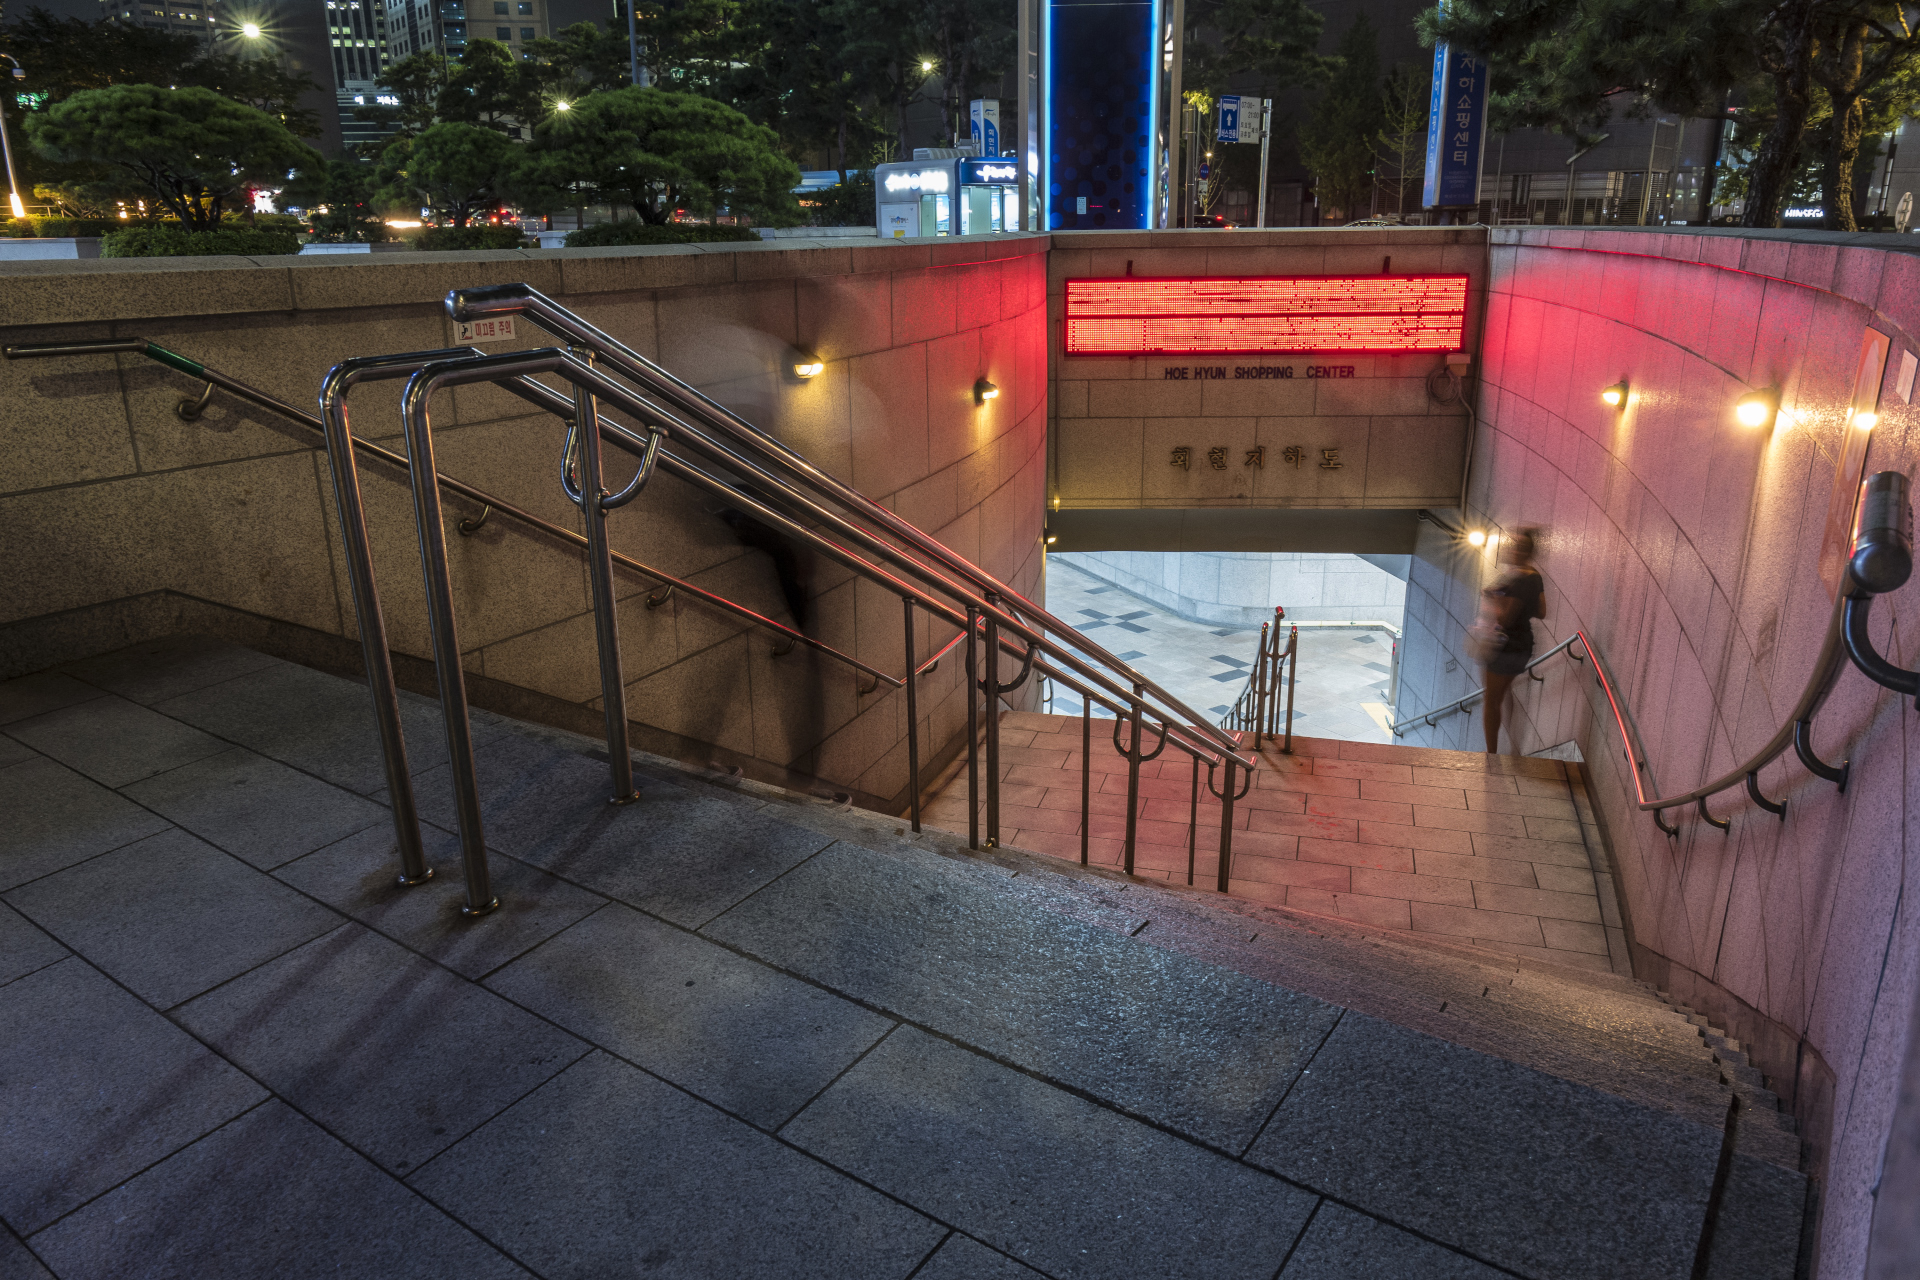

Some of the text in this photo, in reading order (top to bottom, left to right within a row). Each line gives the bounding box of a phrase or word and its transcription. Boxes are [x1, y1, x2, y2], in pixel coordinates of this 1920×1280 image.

[475, 320, 511, 337] 미끄럼 주의
[1165, 365, 1355, 380] HOE HYUN SHOPPING CENTER
[1171, 446, 1343, 471] 회현지하도
